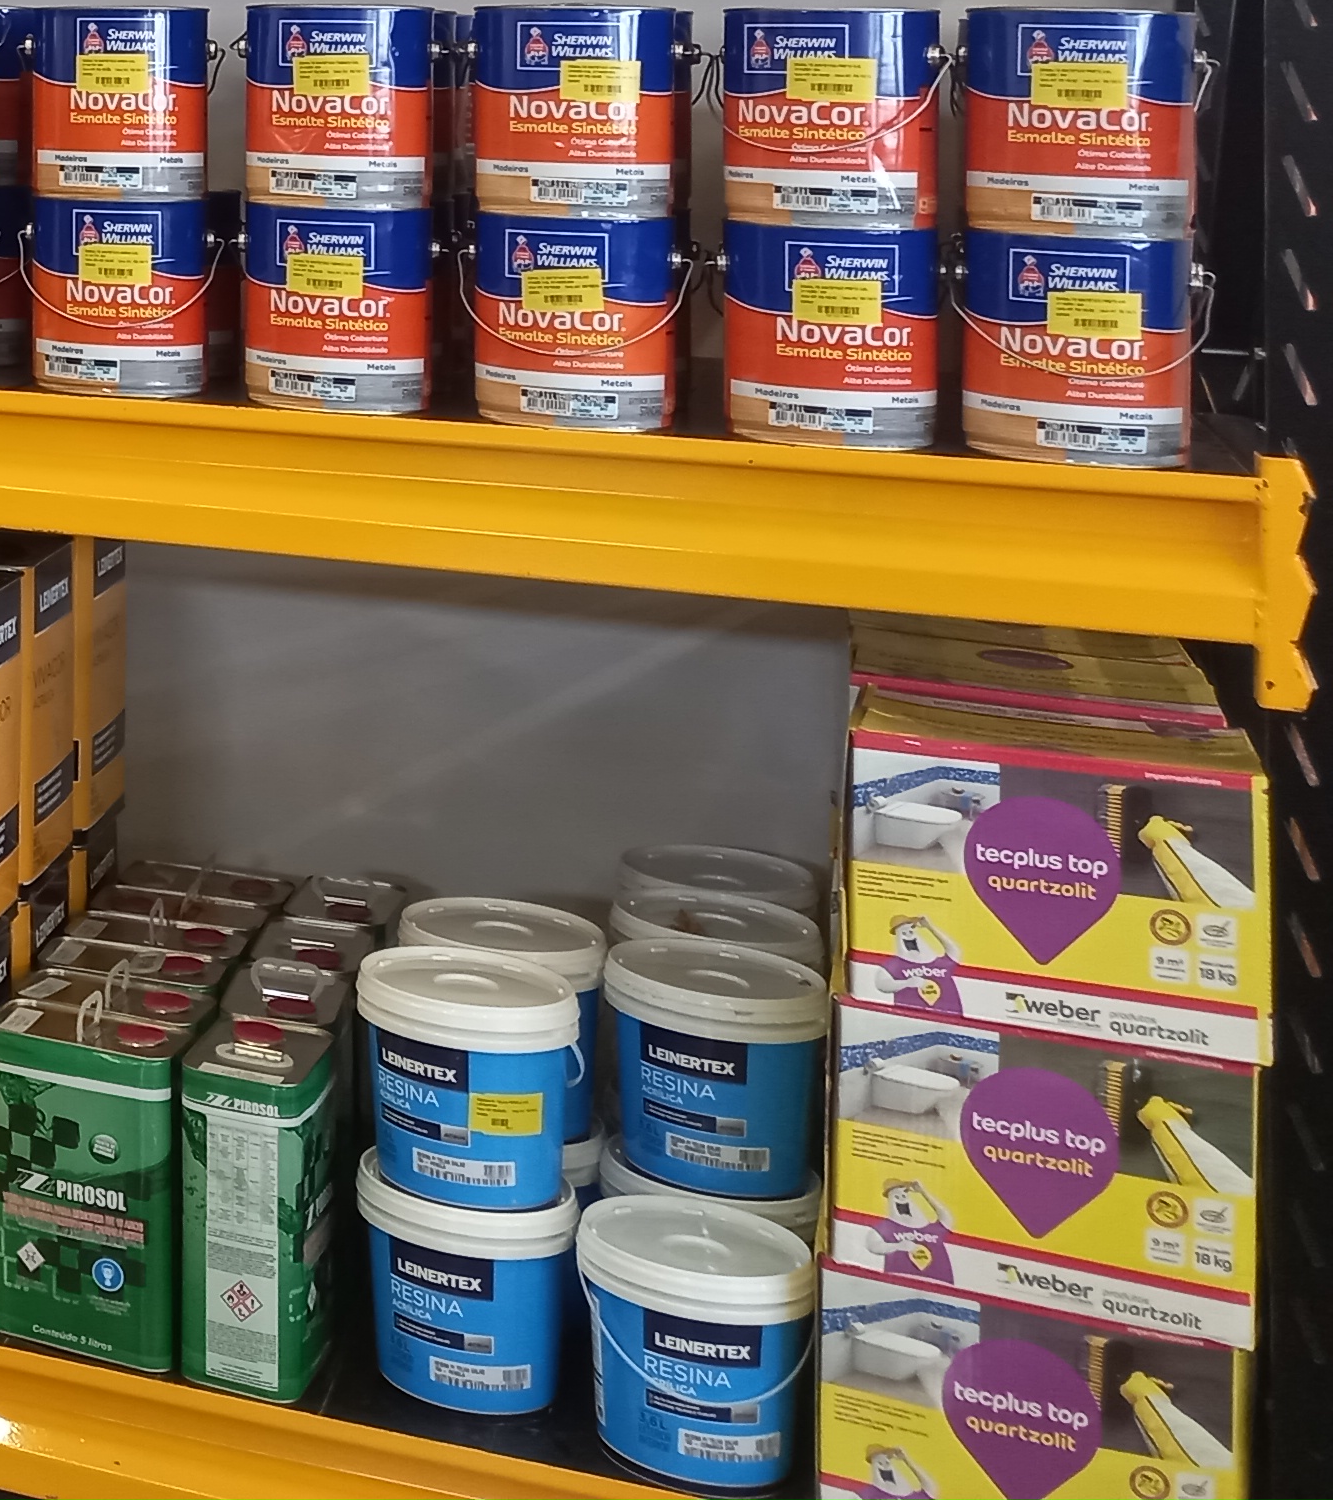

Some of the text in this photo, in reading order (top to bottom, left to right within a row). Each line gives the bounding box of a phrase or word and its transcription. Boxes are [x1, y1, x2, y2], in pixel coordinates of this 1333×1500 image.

[310, 31, 366, 42] SHERWIN
[1059, 37, 1127, 50] SHERWIN
[103, 221, 152, 233] SHERWIN
[825, 256, 887, 269] SHERWIN
[270, 315, 388, 331] Esmalte Sintético
[776, 345, 912, 362] Esmalte Sintético
[601, 379, 633, 388] Metais
[755, 388, 798, 399] Madeiras
[891, 396, 918, 404] Metais
[976, 843, 1108, 877] tecplus top
[988, 873, 1097, 901] quartzolit
[902, 965, 947, 979] weber
[1199, 968, 1214, 982] 18
[1025, 997, 1100, 1023] weber
[1109, 1019, 1209, 1046] quartzolit
[648, 1044, 735, 1076] LEINERTEX
[233, 1098, 280, 1118] PIROSOL
[972, 1112, 1107, 1155] tecplus top
[984, 1143, 1093, 1177] quartzolit
[57, 1179, 127, 1211] PIROSOL
[893, 1230, 939, 1243] weber
[397, 1258, 482, 1292] LEINERTEX
[1195, 1251, 1233, 1272] 18 kg
[391, 1279, 463, 1317] RESINA
[1017, 1271, 1093, 1298] weber
[1102, 1297, 1202, 1330] quartzolit
[33, 1324, 78, 1342] Conteúdo
[88, 1338, 112, 1351] litros
[655, 1331, 751, 1360] LEINERTEX
[643, 1356, 731, 1389] RESINA
[954, 1382, 1042, 1417] tecplus
[1048, 1401, 1089, 1430] top
[966, 1414, 1076, 1451] quartzolit
